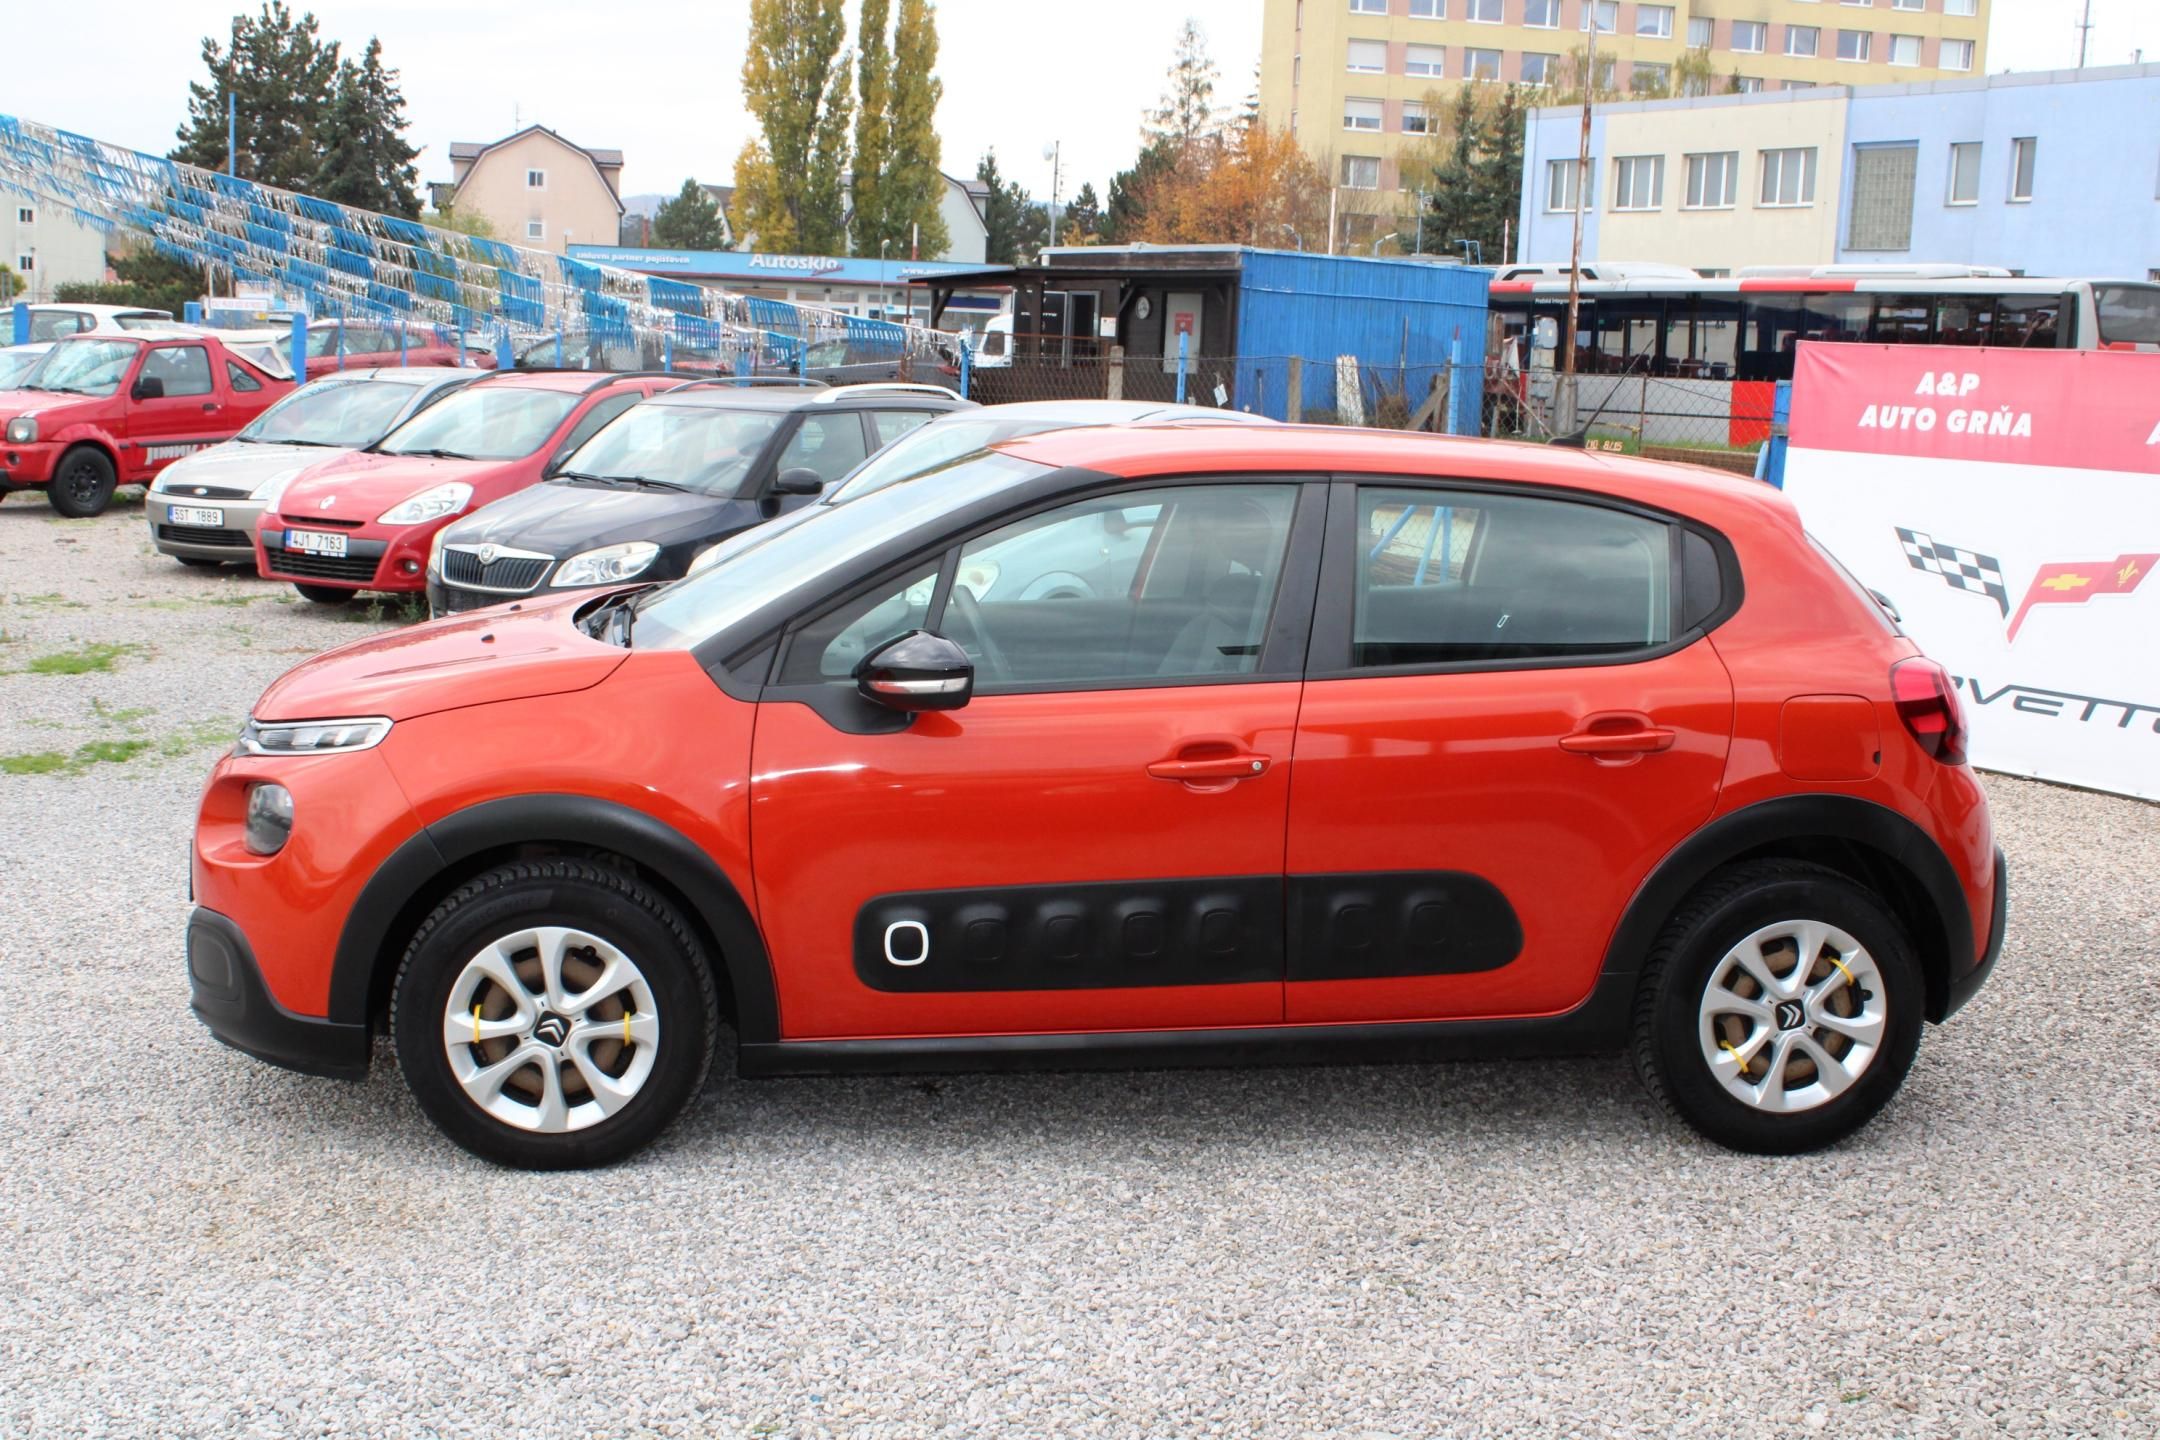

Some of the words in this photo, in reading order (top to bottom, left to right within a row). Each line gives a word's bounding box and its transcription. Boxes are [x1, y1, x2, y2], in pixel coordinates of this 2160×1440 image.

[612, 253, 644, 262] partner
[749, 253, 838, 270] Autosklo
[1915, 371, 1980, 397] A&P
[1858, 404, 1937, 432] AUTO
[1946, 405, 2032, 437] GRŇA
[174, 508, 189, 521] 5ST
[196, 510, 218, 523] 1889
[293, 532, 310, 547] 4J1
[317, 534, 342, 550] 7163
